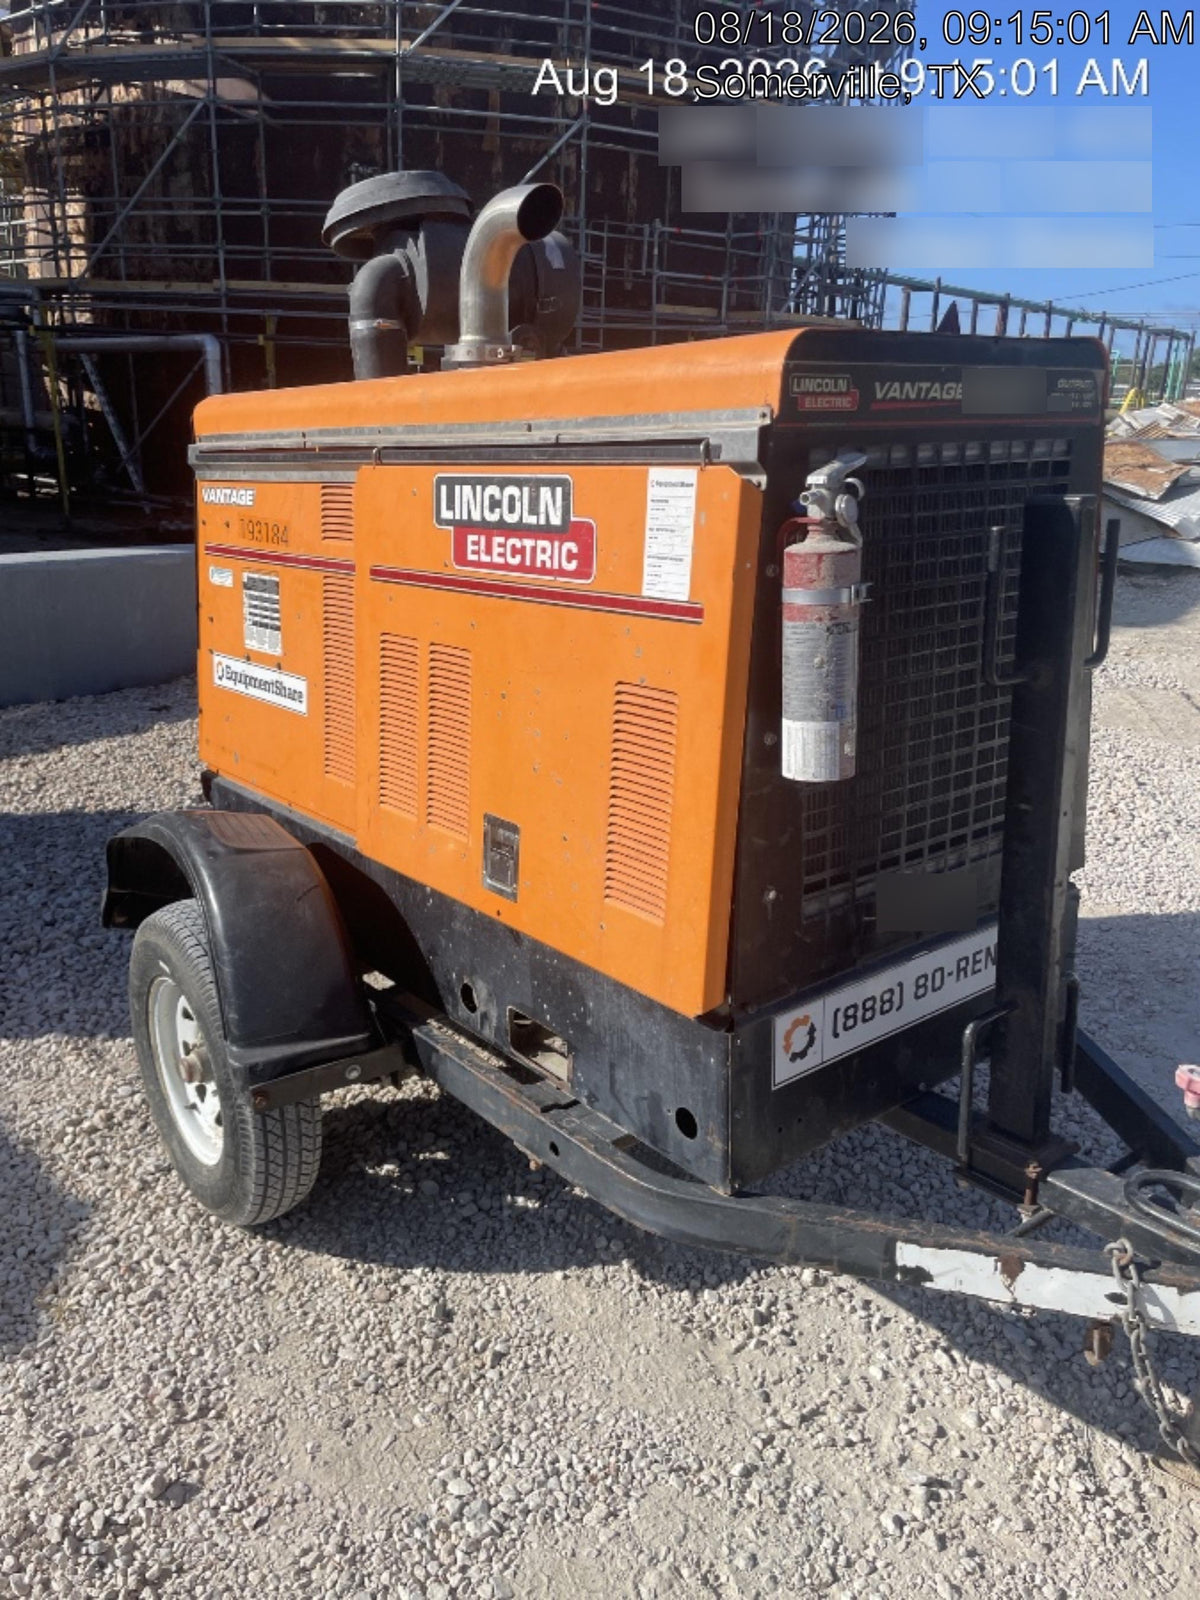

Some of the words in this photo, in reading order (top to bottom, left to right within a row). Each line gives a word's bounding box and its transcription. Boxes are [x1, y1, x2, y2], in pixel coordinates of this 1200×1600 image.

[793, 378, 848, 392] LINCOLN
[805, 397, 853, 409] ELECTRIC
[202, 487, 255, 506] VANTAGE
[440, 484, 563, 526] LINCOLN
[466, 534, 578, 571] ELECTRIC
[225, 664, 304, 704] EquipmentShare
[832, 981, 904, 1039] (888)
